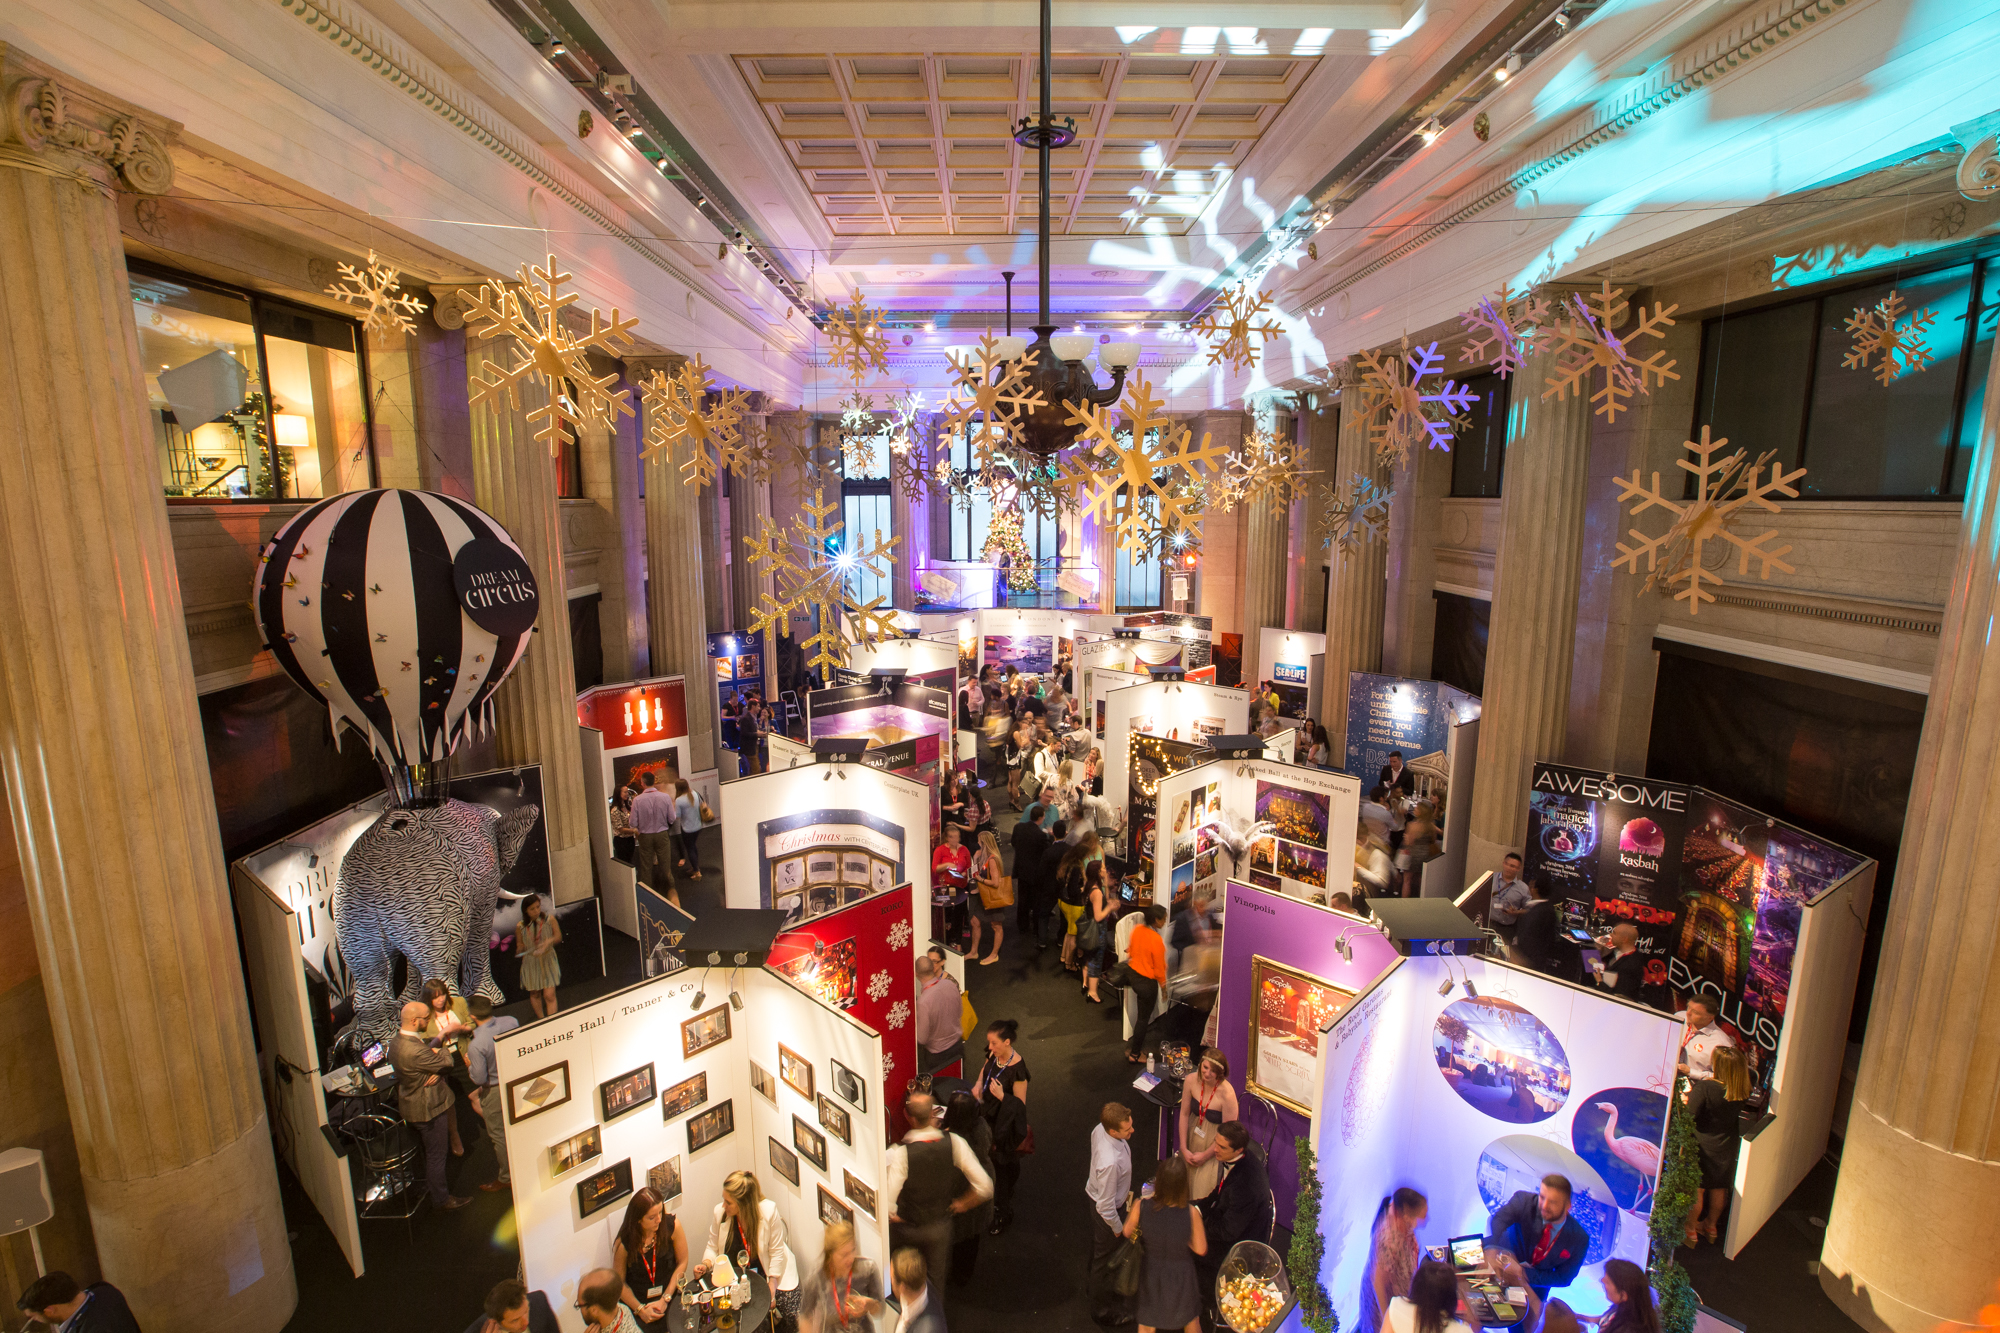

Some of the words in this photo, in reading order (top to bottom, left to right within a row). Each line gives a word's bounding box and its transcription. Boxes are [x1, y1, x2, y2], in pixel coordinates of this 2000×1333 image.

[471, 569, 520, 587] DREAM
[1081, 643, 1111, 656] GLAZIERS
[1275, 666, 1290, 677] SEA
[1371, 691, 1384, 700] For
[1369, 708, 1413, 722] Christmas
[1370, 701, 1428, 715] unforble
[1368, 726, 1390, 736] need
[1391, 731, 1404, 739] an
[1369, 718, 1394, 729] event,
[1395, 722, 1412, 731] you
[1368, 735, 1394, 745] iconic
[1395, 740, 1423, 750] venue.
[1366, 748, 1389, 766] D&
[1268, 768, 1281, 776] Ball
[1291, 773, 1301, 782] the
[1304, 777, 1317, 786] Hop
[1318, 780, 1352, 794] Exchange
[1535, 771, 1687, 813] AWESOME
[1553, 811, 1593, 827] magical
[779, 830, 841, 851] Christmas
[861, 838, 890, 854] CENTERPLATE
[1619, 853, 1659, 873] kasbah
[880, 900, 904, 915] KOKO
[1233, 895, 1276, 915] Vinopolis
[1267, 977, 1293, 990] vinopolis
[516, 1029, 575, 1059] Banking
[579, 1015, 606, 1034] Hall
[611, 1009, 617, 1022] /
[621, 994, 663, 1017] Tanner
[667, 989, 676, 998] &
[680, 982, 695, 994] Co
[1334, 1040, 1340, 1050] &
[1341, 1018, 1363, 1044] Babylon
[1364, 989, 1392, 1020] Restaurant
[1336, 1024, 1346, 1038] The
[1347, 1007, 1361, 1027] Roof
[1362, 988, 1384, 1012] Gardens
